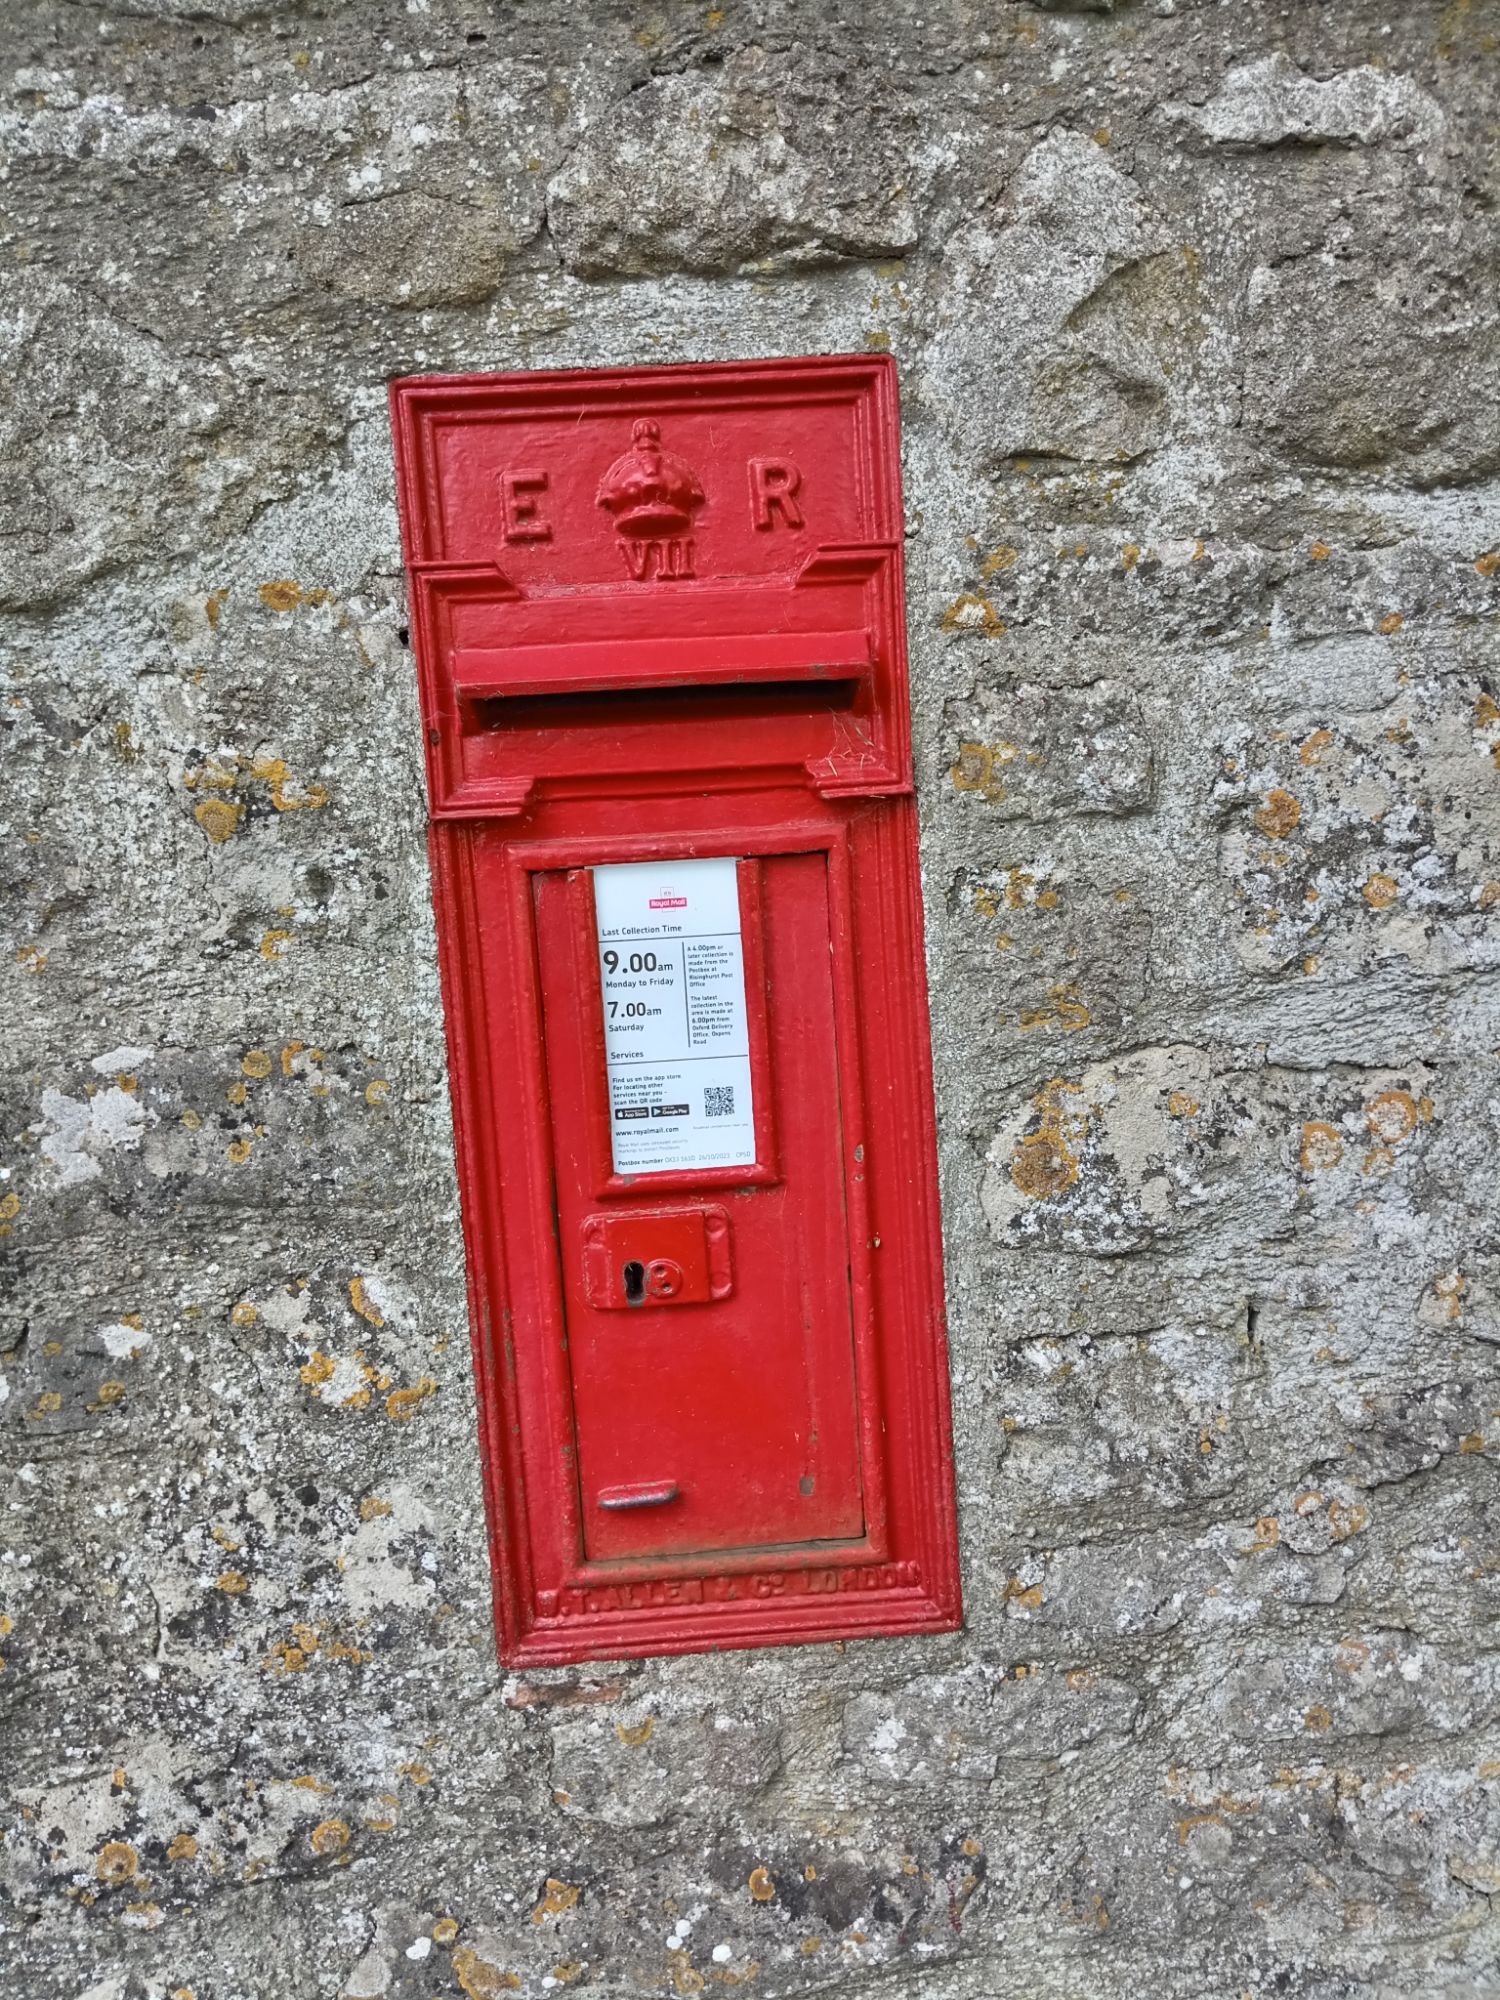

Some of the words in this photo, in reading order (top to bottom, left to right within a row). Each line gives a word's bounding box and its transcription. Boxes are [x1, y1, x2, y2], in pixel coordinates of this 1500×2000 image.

[500, 469, 553, 543] E
[747, 457, 805, 532] R
[617, 538, 697, 581] VII
[651, 899, 670, 908] Royal
[671, 898, 687, 906] Mail
[602, 927, 619, 936] Last
[622, 926, 660, 935] Collection
[661, 924, 682, 933] Time
[603, 950, 674, 975] 9.00am
[606, 979, 637, 989] Monday
[649, 977, 674, 986] Friday
[607, 1001, 662, 1018] 7.00am
[608, 1024, 645, 1032] Saturday
[610, 1050, 644, 1060] Services
[616, 1127, 680, 1136] www.royalmail.com
